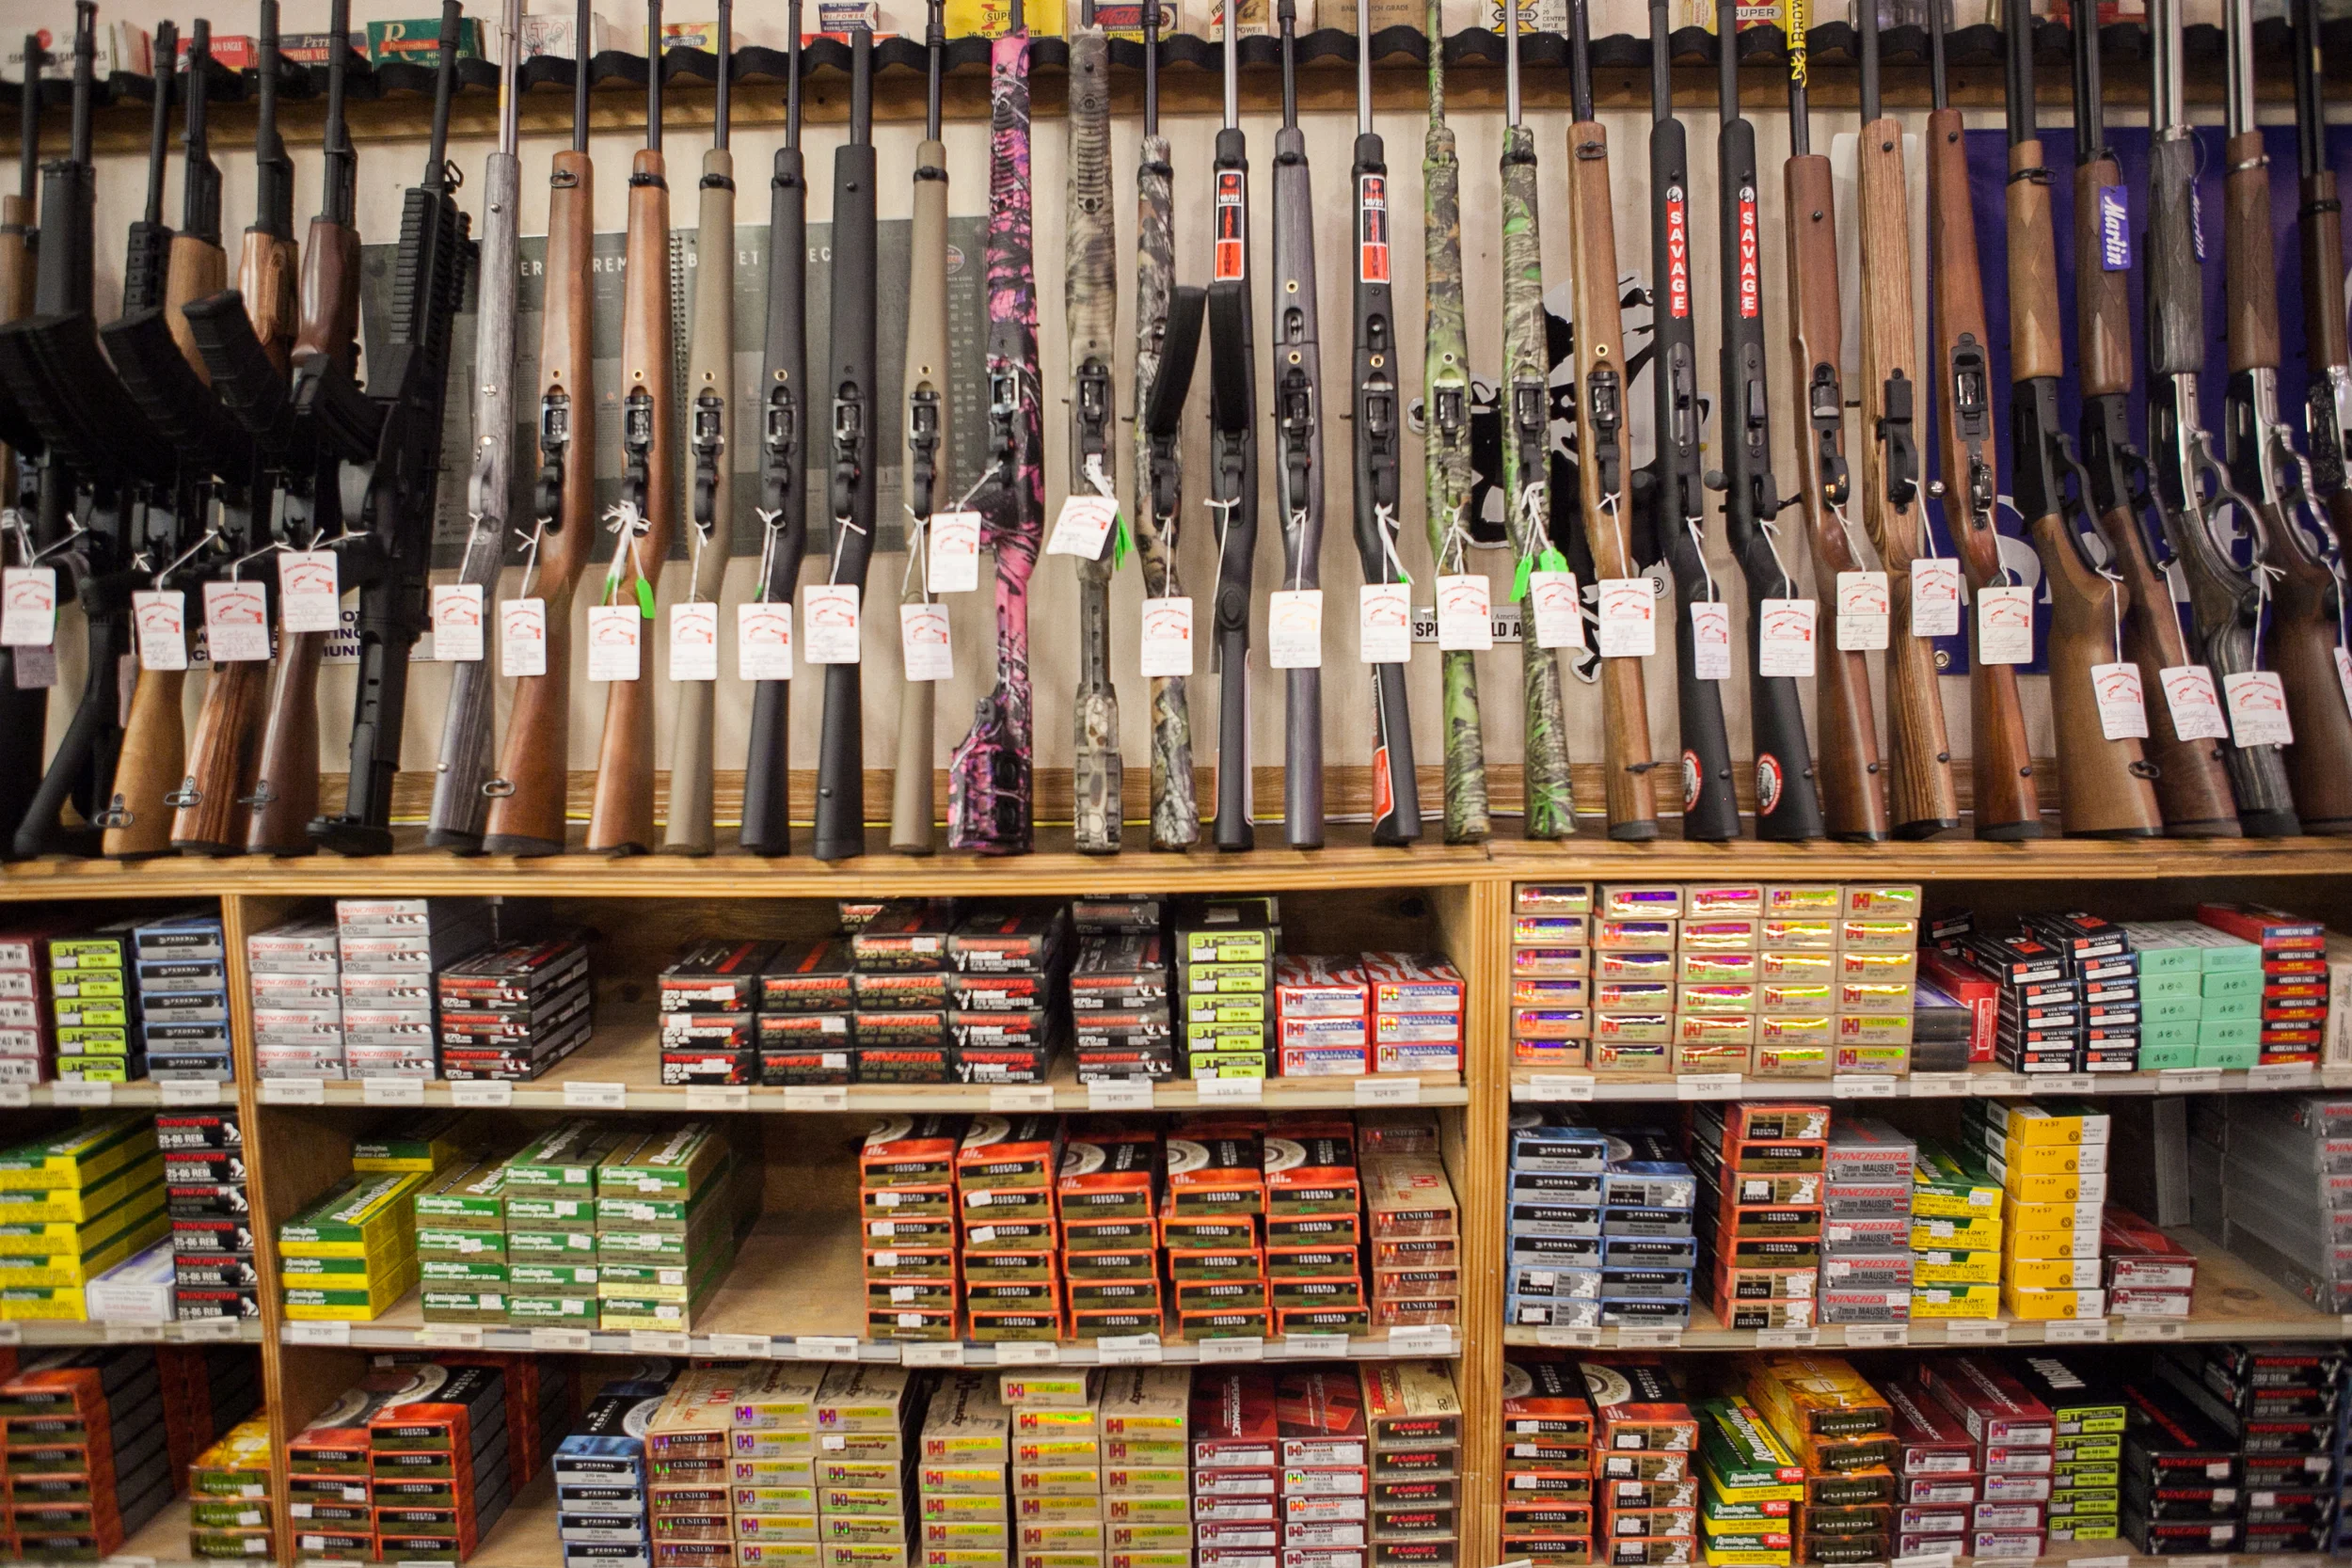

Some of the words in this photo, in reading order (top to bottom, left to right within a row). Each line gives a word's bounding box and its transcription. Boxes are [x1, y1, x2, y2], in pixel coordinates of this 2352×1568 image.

[2105, 194, 2126, 266] Marlin
[1669, 211, 1685, 310] SAVAGE
[1741, 211, 1756, 310] SAVAGE
[1832, 1152, 1908, 1161] WINCHESTER
[1829, 1188, 1906, 1196] WINCHESTER
[1915, 1186, 1953, 1195] Remington
[1399, 1242, 1436, 1250] CUSTOM
[1821, 1422, 1876, 1431] FUSION
[1831, 1455, 1883, 1465] FUSION
[1730, 1472, 1771, 1481] Remington
[1715, 1505, 1756, 1513] Remington
